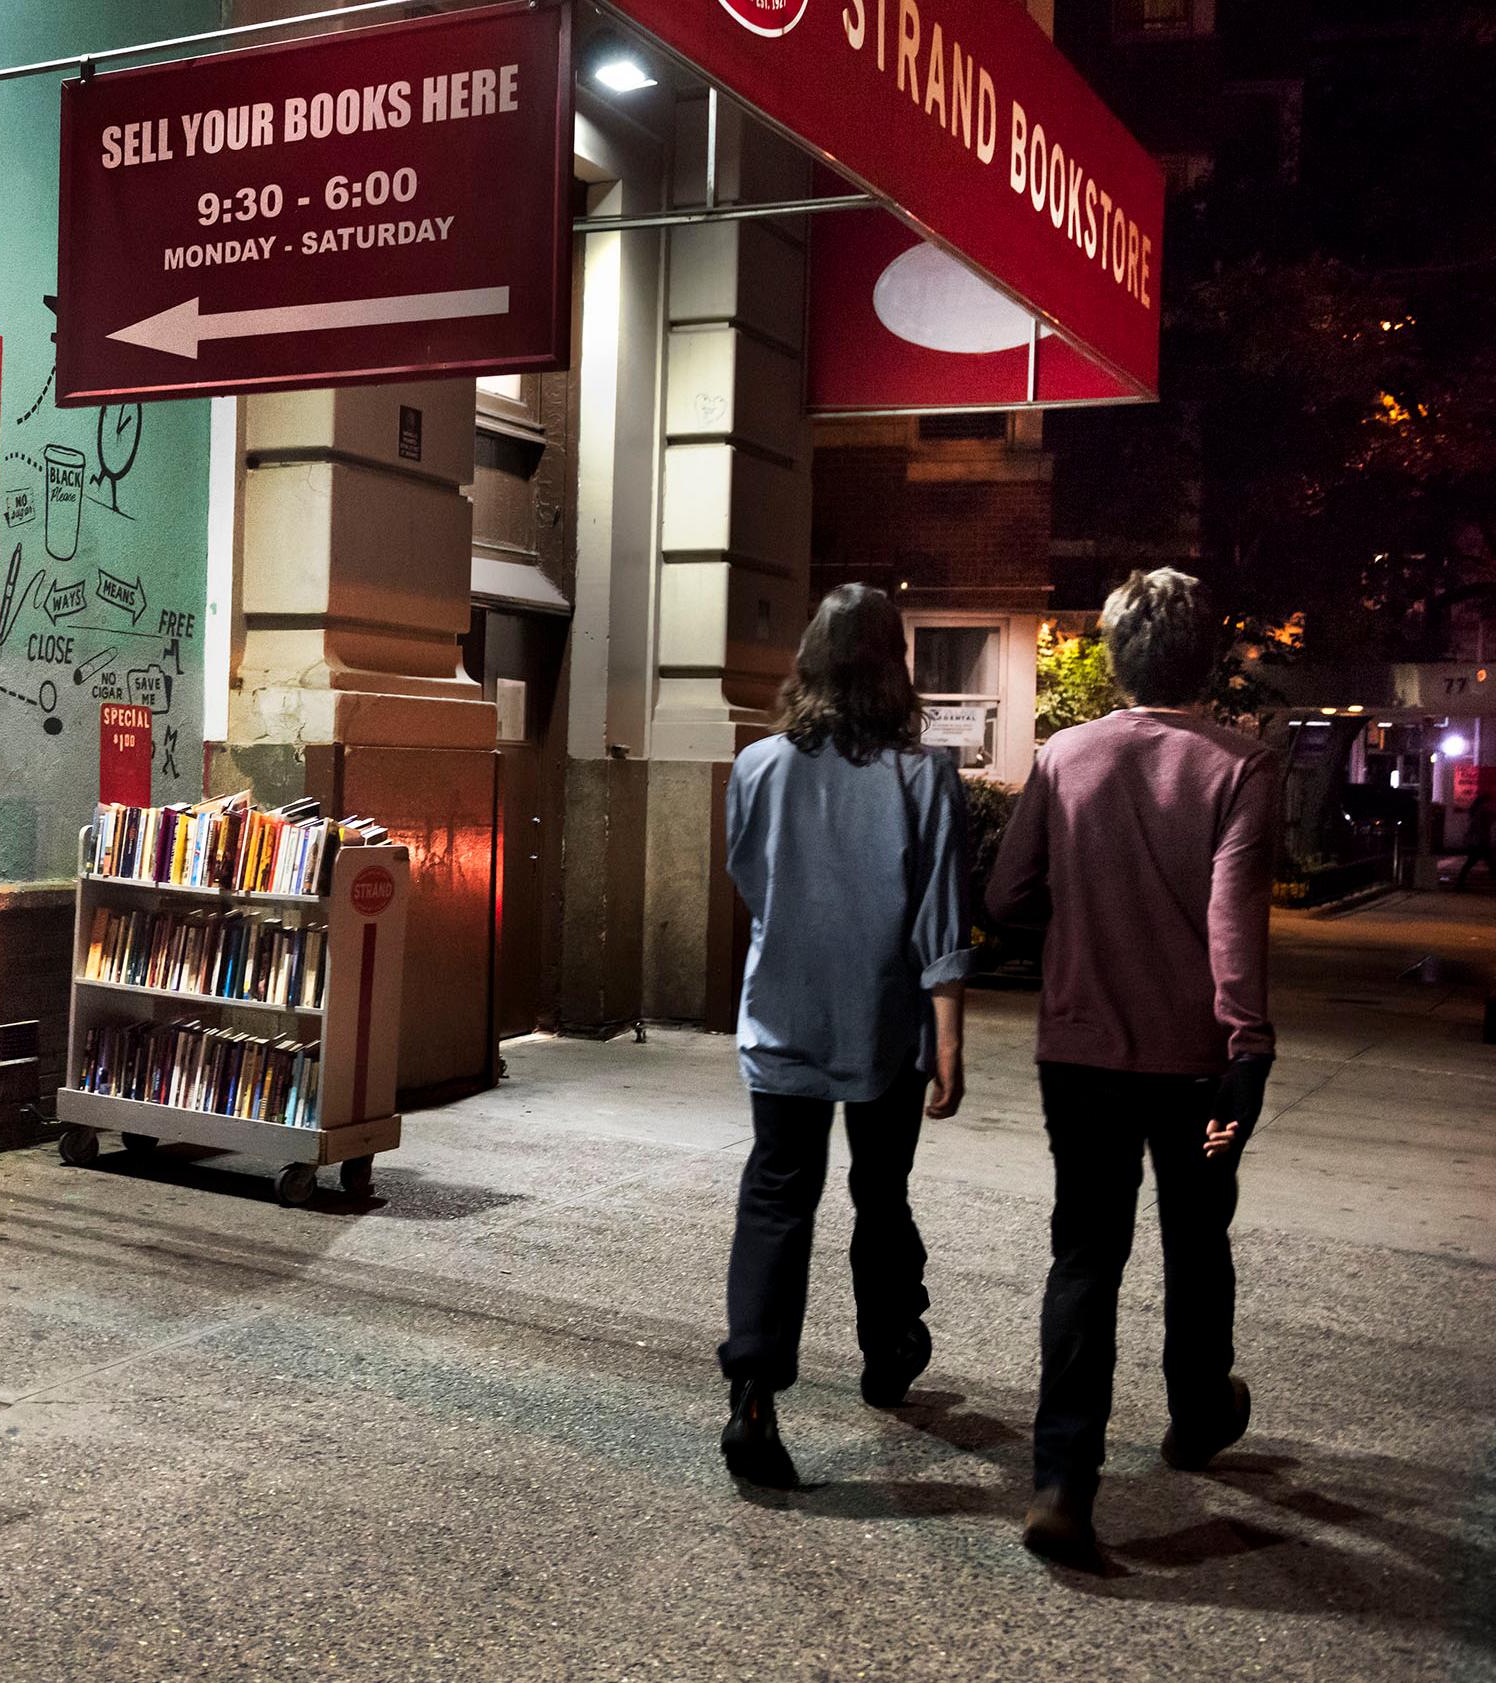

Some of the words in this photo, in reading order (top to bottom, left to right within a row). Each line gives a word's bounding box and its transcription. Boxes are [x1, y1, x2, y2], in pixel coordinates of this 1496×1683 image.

[102, 125, 173, 169] SELL
[180, 101, 273, 157] YOUR
[284, 80, 412, 144] BOOKS
[422, 64, 519, 124] HERE
[197, 184, 284, 226] 9:30
[324, 166, 418, 211] 6:00
[1010, 101, 1152, 309] BOOKSTORE
[163, 236, 276, 271] MONDAY
[301, 216, 455, 255] SATURDAY
[49, 466, 81, 489] BLACK
[14, 493, 28, 507] NO
[50, 487, 77, 503] Please
[53, 589, 82, 612] WAYS
[104, 577, 136, 606] MEANS
[159, 609, 195, 639] FREE
[27, 633, 74, 664] CLOSE
[101, 672, 117, 686] NO
[135, 677, 161, 690] SAVE
[92, 685, 123, 700] CIGAR
[141, 693, 156, 706] ME
[103, 707, 150, 729] SPECIAL
[354, 883, 392, 898] STRAND
